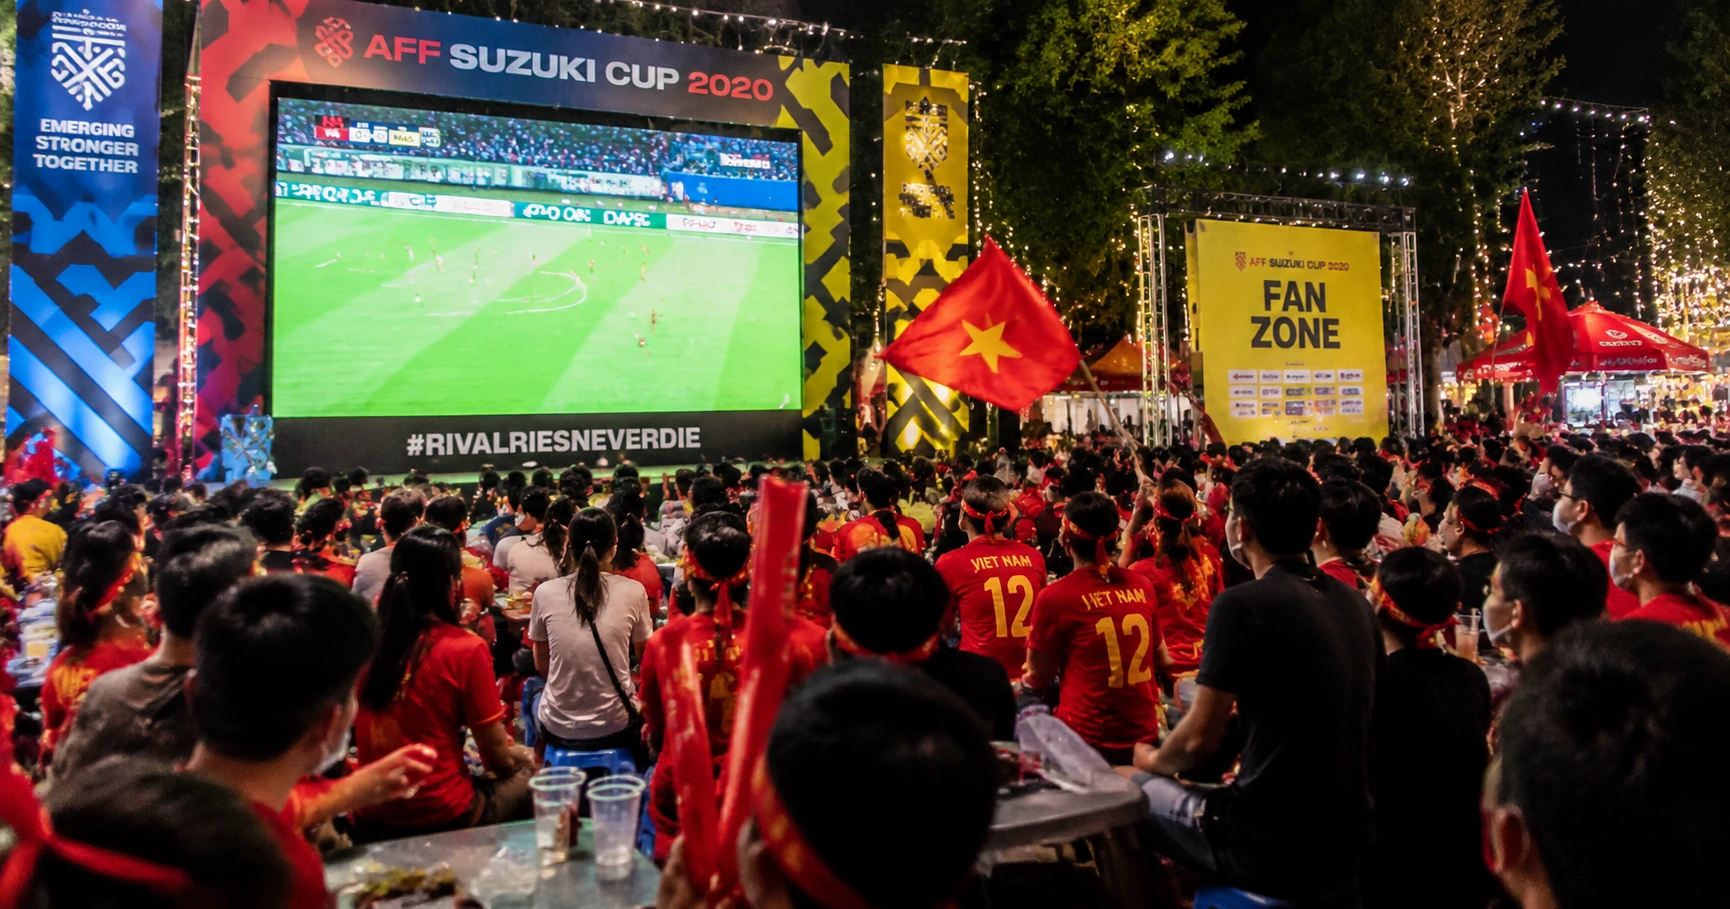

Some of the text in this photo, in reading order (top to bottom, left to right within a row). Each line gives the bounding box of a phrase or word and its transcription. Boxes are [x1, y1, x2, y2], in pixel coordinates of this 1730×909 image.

[364, 35, 774, 101] AFF SUZUKI CUP 2020
[40, 118, 135, 138] EMERGING
[35, 135, 139, 157] STRONGER
[32, 153, 138, 174] TOGETHER
[1249, 256, 1266, 267] AFF
[1307, 260, 1326, 270] CUP
[1263, 279, 1327, 313] FAN
[1250, 316, 1341, 350] ZONE
[406, 426, 701, 457] #RIVALRIESNEVERDIE
[970, 554, 1032, 574] VIET NAM
[983, 574, 1034, 638] 12
[1115, 588, 1147, 604] NAM
[1095, 613, 1152, 689] 12
